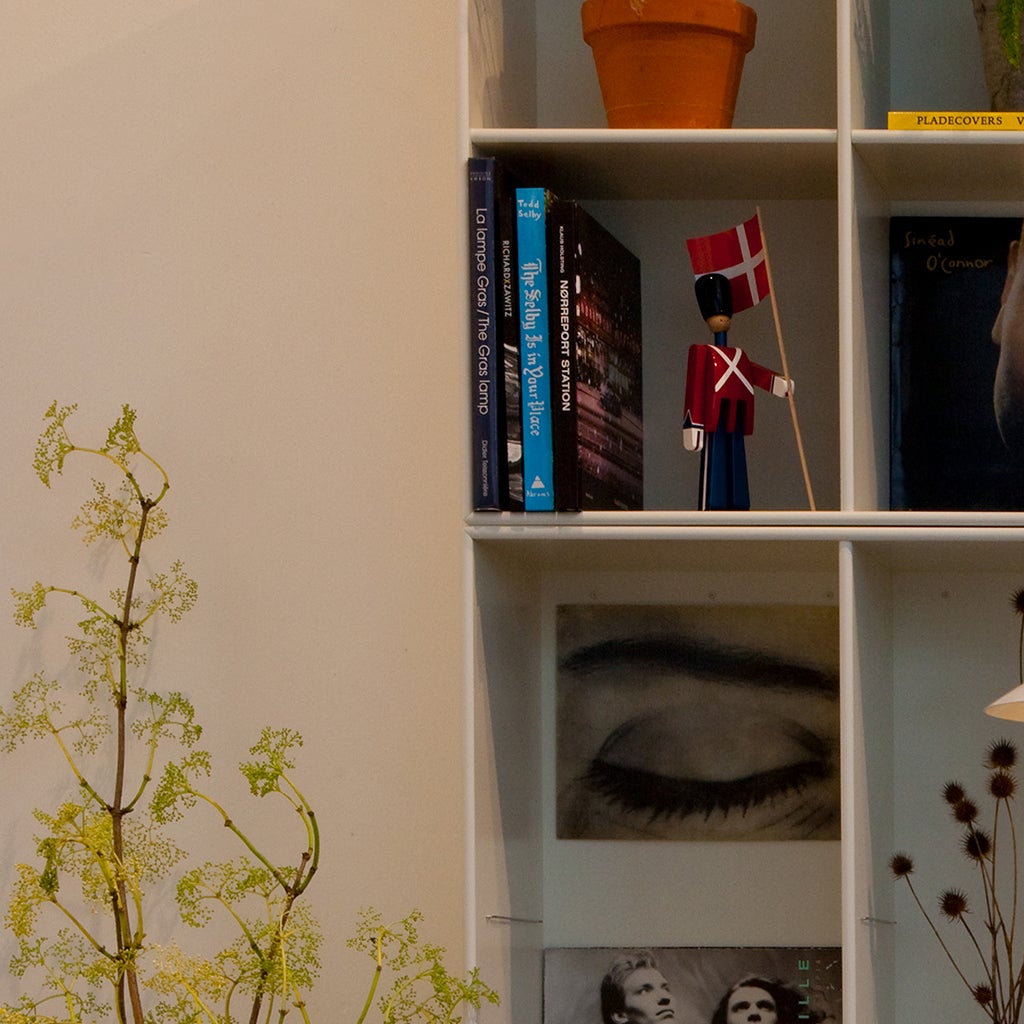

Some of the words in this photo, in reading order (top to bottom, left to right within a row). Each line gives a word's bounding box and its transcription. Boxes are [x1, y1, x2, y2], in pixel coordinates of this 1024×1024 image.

[916, 115, 1003, 126] PLADECOVERS
[476, 207, 488, 224] La
[517, 199, 540, 209] Todd
[517, 209, 542, 222] Selby
[475, 228, 488, 272] lampe
[904, 229, 955, 248] Sinéad
[520, 258, 542, 287] The
[926, 252, 993, 274] O'Connor
[477, 275, 489, 308] Gras
[521, 289, 542, 330] Selby
[559, 279, 570, 356] NØRREPORT
[477, 316, 490, 341] The
[524, 333, 543, 349] Is
[478, 344, 490, 377] Gras
[477, 379, 491, 415] lamp
[523, 365, 544, 399] Your
[560, 359, 571, 412] STATION
[527, 400, 545, 437] Place
